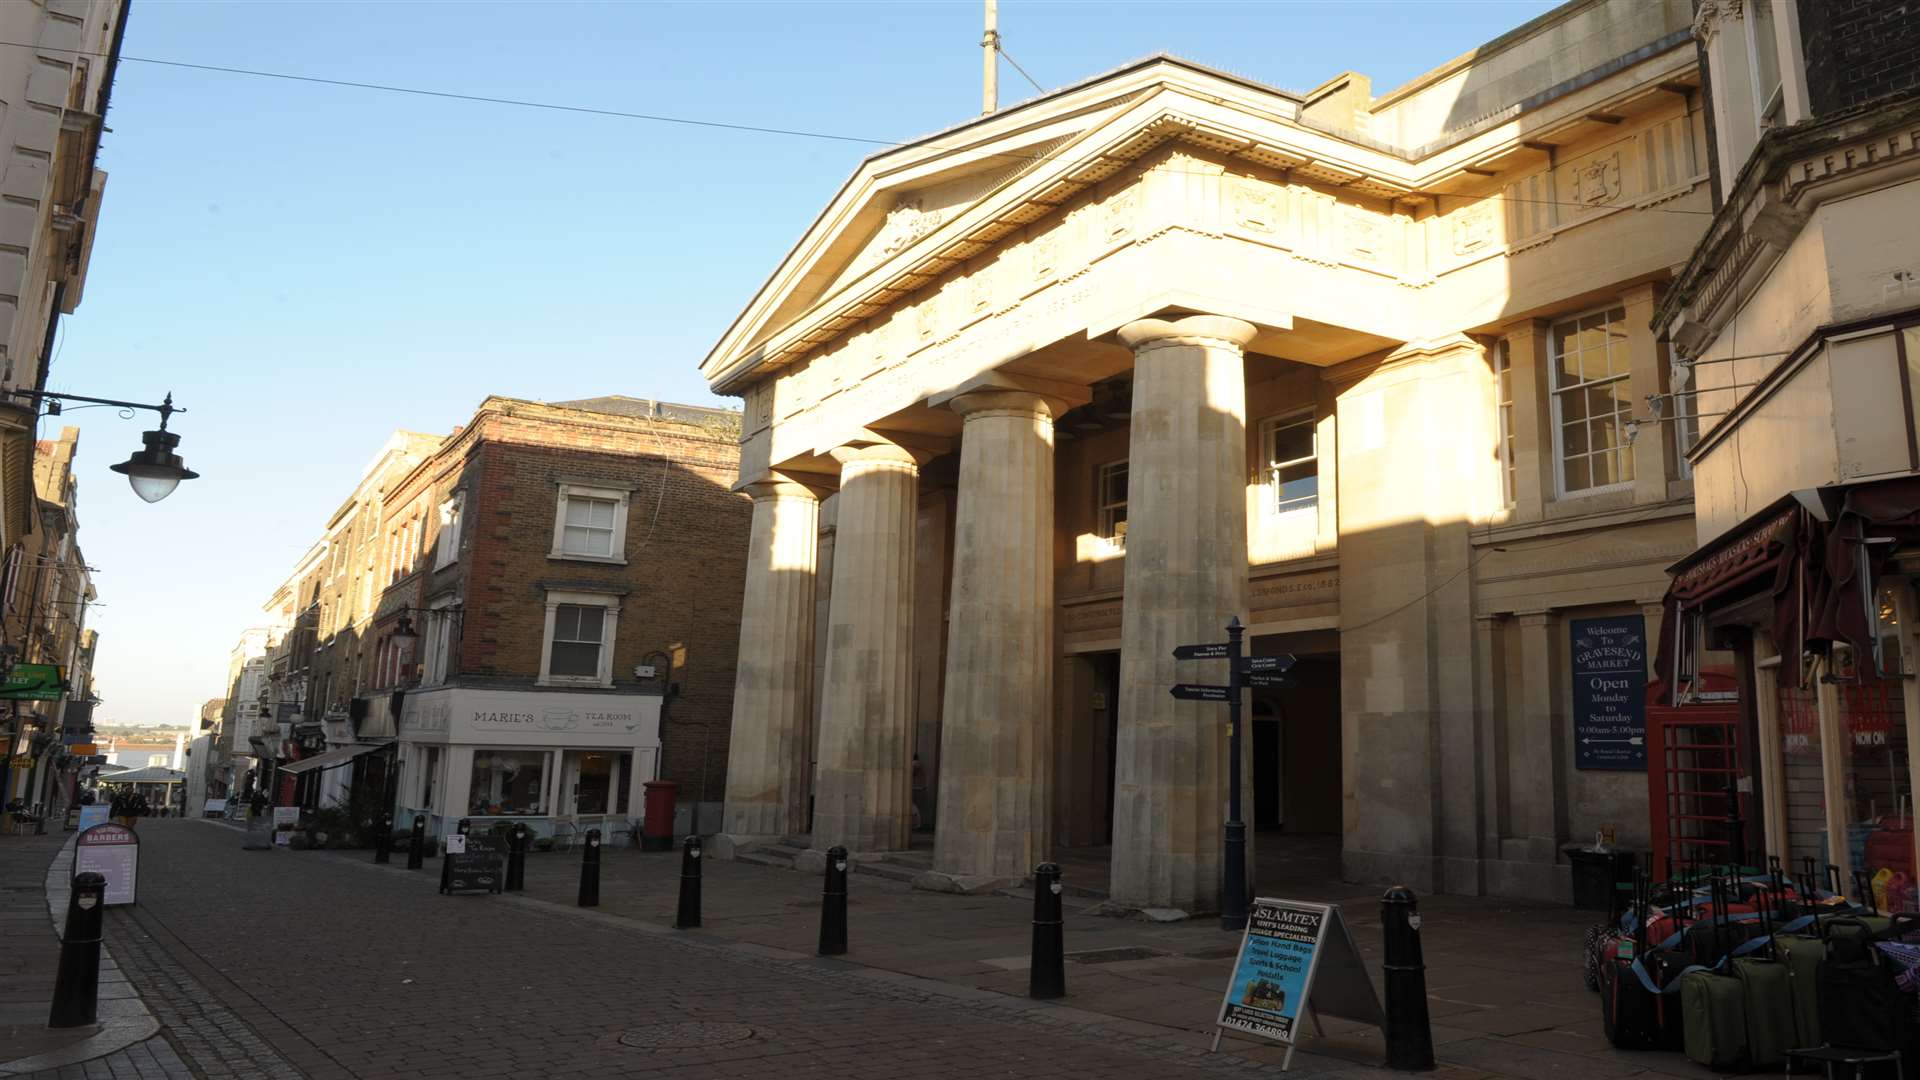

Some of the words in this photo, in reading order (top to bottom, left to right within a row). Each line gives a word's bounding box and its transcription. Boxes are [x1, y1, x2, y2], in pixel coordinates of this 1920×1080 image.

[1587, 626, 1628, 636] Welcome
[1601, 636, 1614, 645] To
[1576, 647, 1641, 664] GRAVESEND
[1587, 658, 1630, 669] MARKET
[1590, 677, 1629, 692] Open
[1591, 694, 1629, 704] Monday
[474, 711, 535, 723] MARIE'S
[585, 712, 604, 720] TEA
[606, 713, 632, 721] ROOM
[1589, 713, 1633, 723] Saturday
[1855, 732, 1871, 745] NOW
[1873, 732, 1885, 745] ON
[87, 833, 129, 842] BARBERS
[1277, 922, 1308, 933] LEADING
[1272, 930, 1317, 943] SPECIALISTS
[1271, 941, 1291, 950] Hand
[1293, 943, 1312, 955] Bags
[1270, 950, 1302, 964] Luggage
[1275, 961, 1302, 973] School
